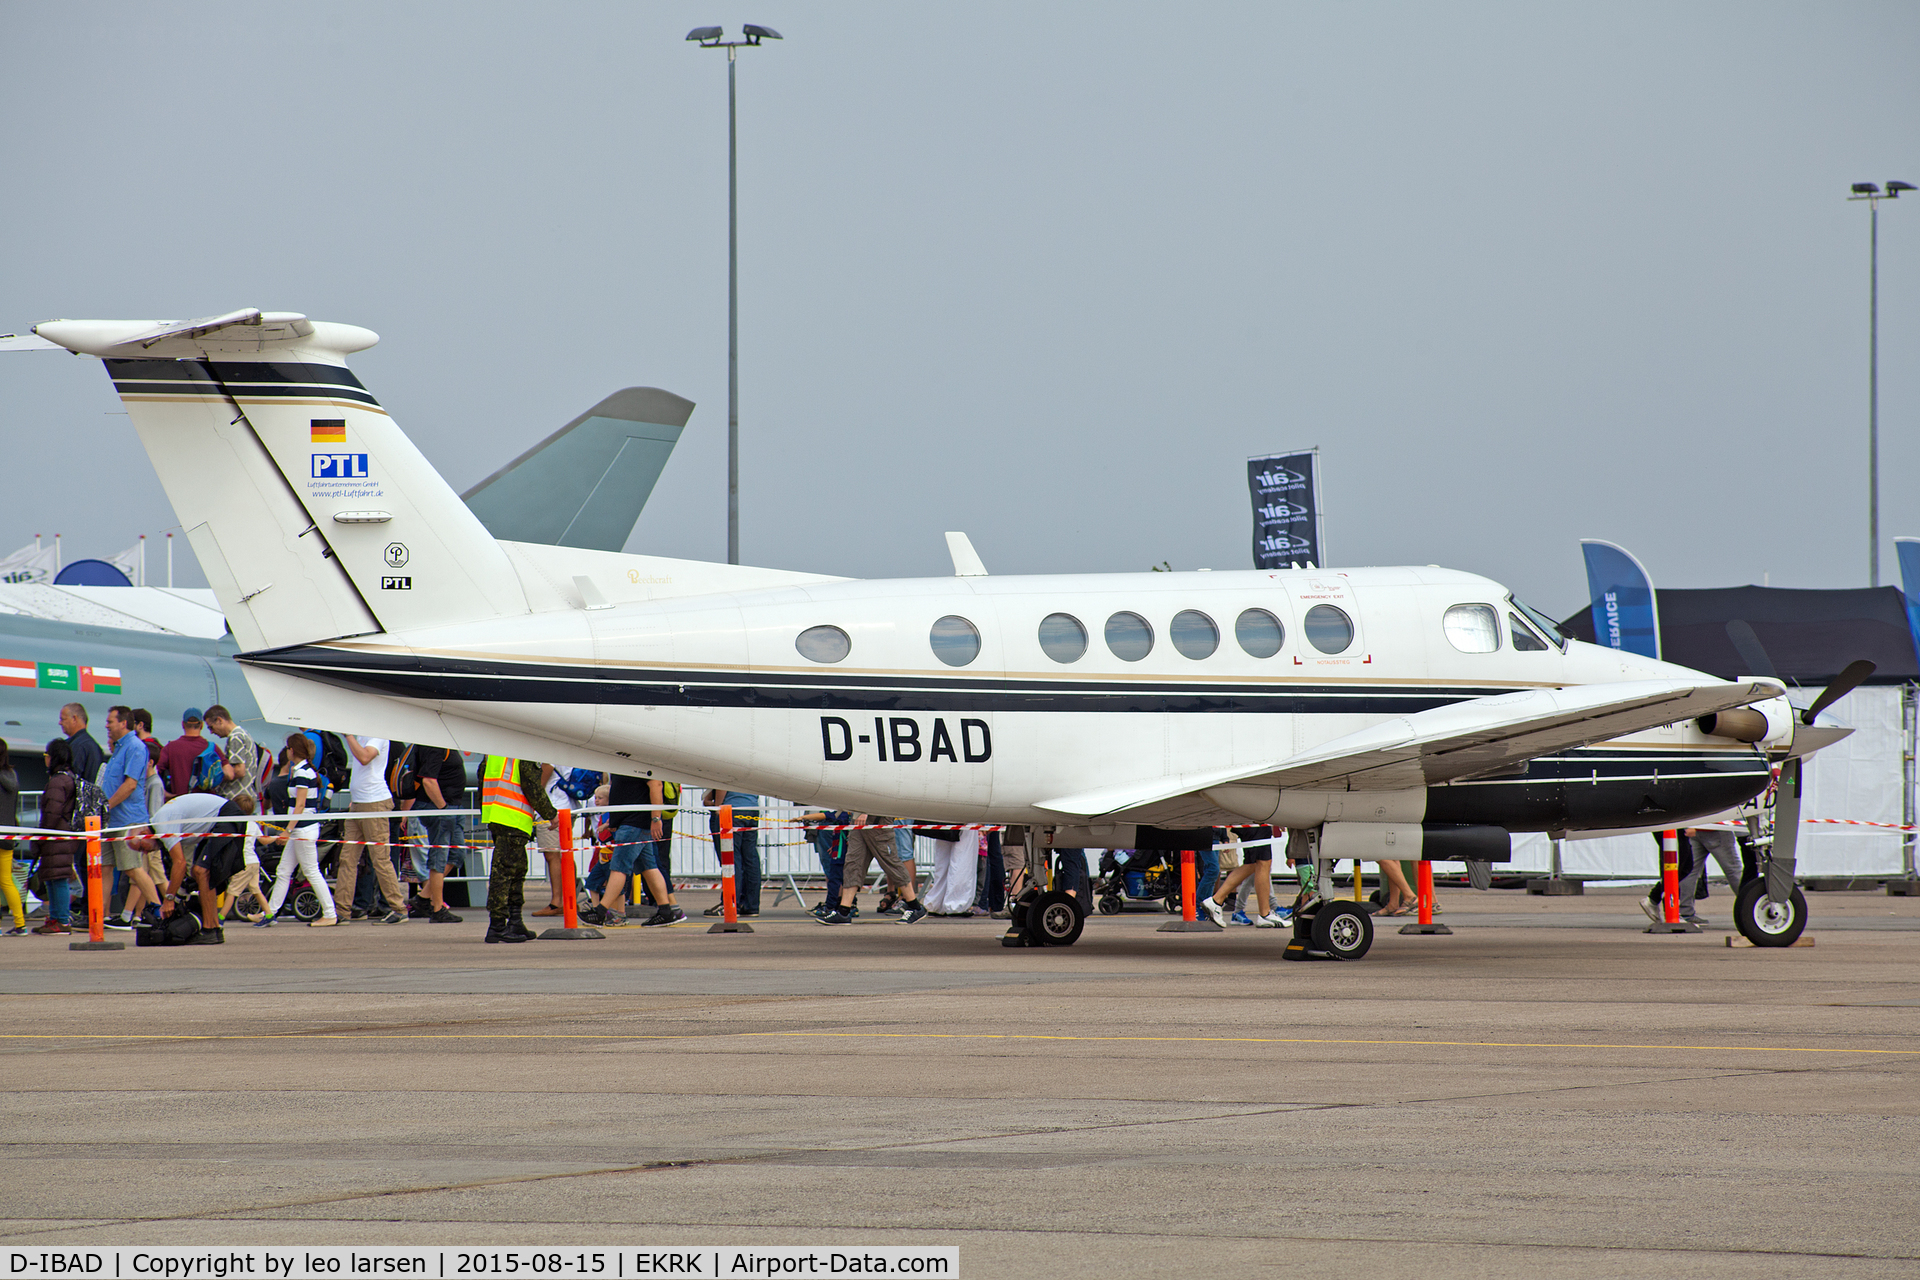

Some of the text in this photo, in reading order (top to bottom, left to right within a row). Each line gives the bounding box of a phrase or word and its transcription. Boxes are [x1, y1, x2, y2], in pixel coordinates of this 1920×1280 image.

[313, 455, 367, 477] PTL
[383, 577, 410, 589] PTL
[627, 568, 673, 584] Beechcraft
[820, 716, 993, 763] D-IBAD
